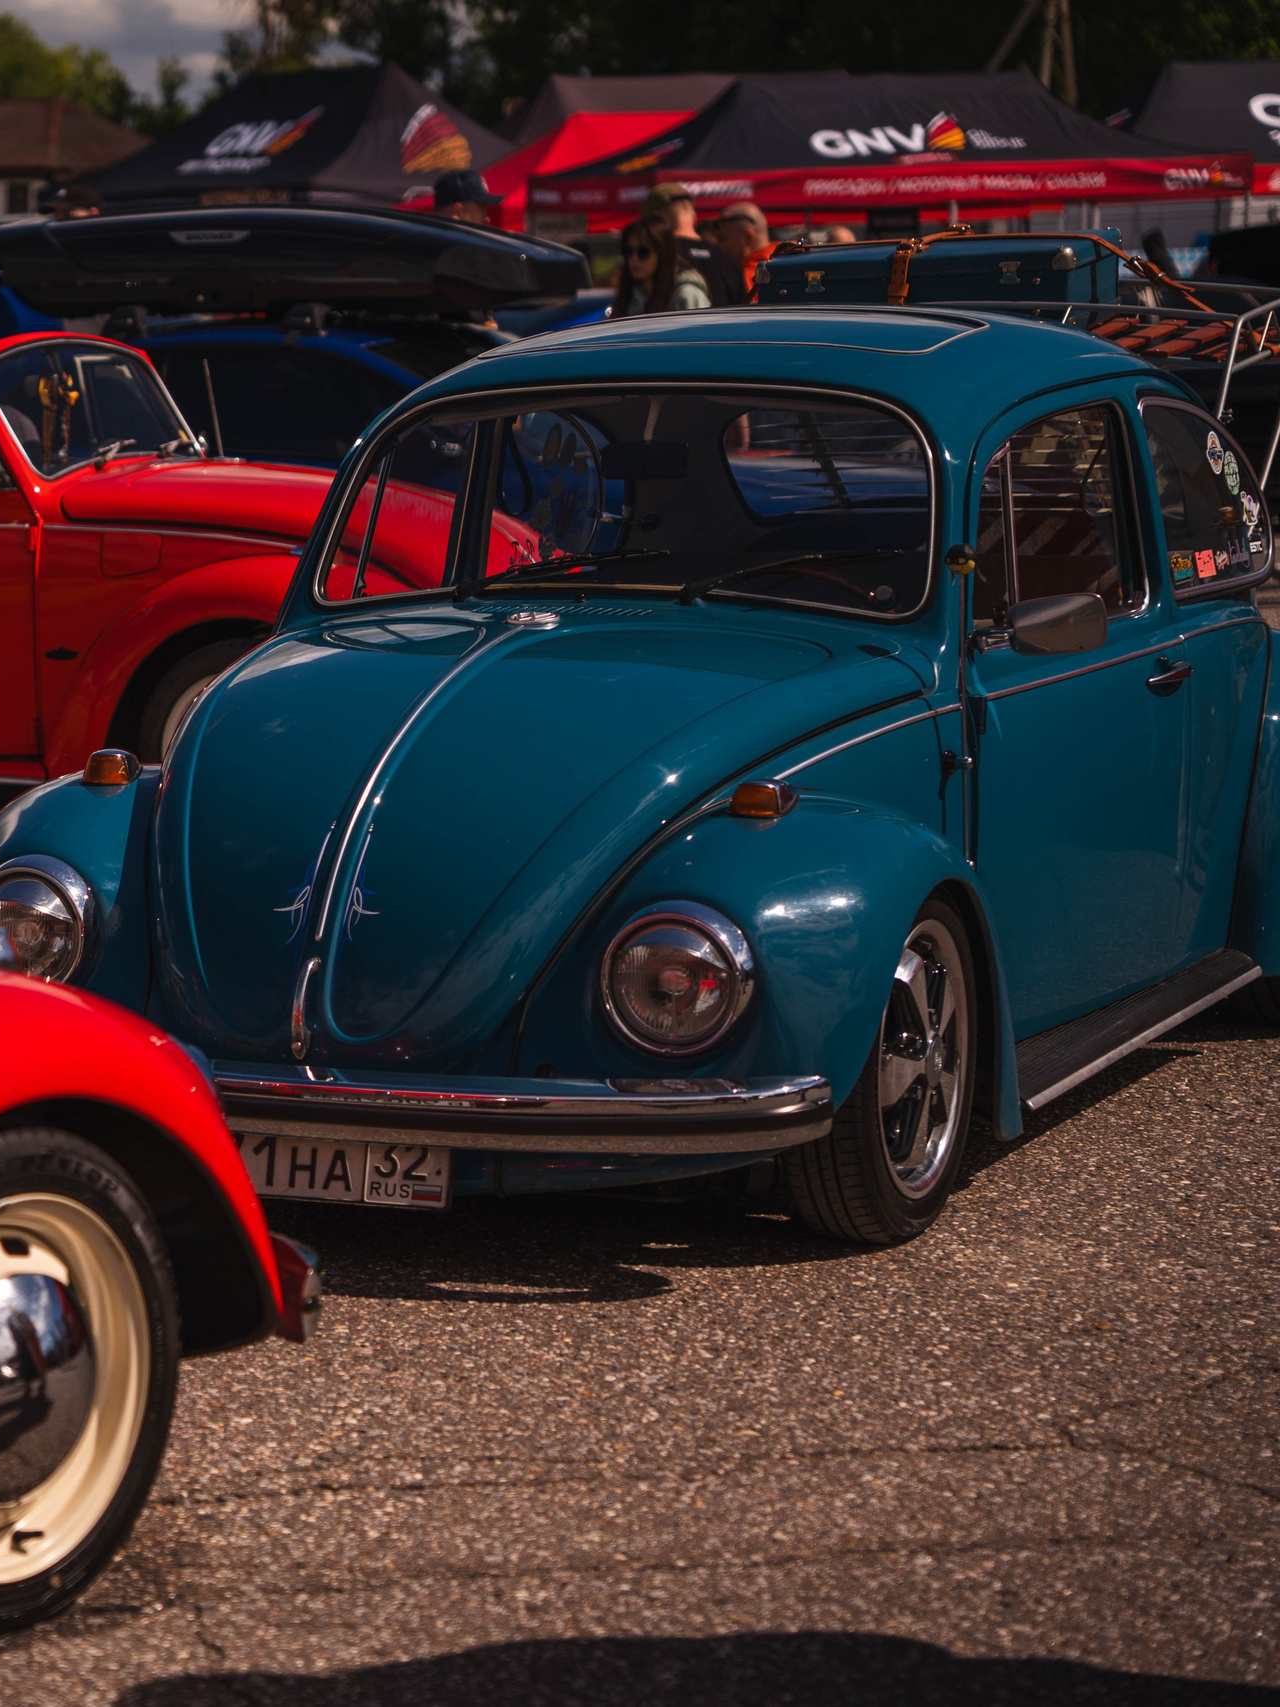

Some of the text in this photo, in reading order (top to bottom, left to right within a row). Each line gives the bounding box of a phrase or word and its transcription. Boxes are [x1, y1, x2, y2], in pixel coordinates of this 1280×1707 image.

[809, 123, 926, 158] GNV
[235, 1134, 431, 1192] 1HA 32
[370, 1181, 411, 1198] RUS
